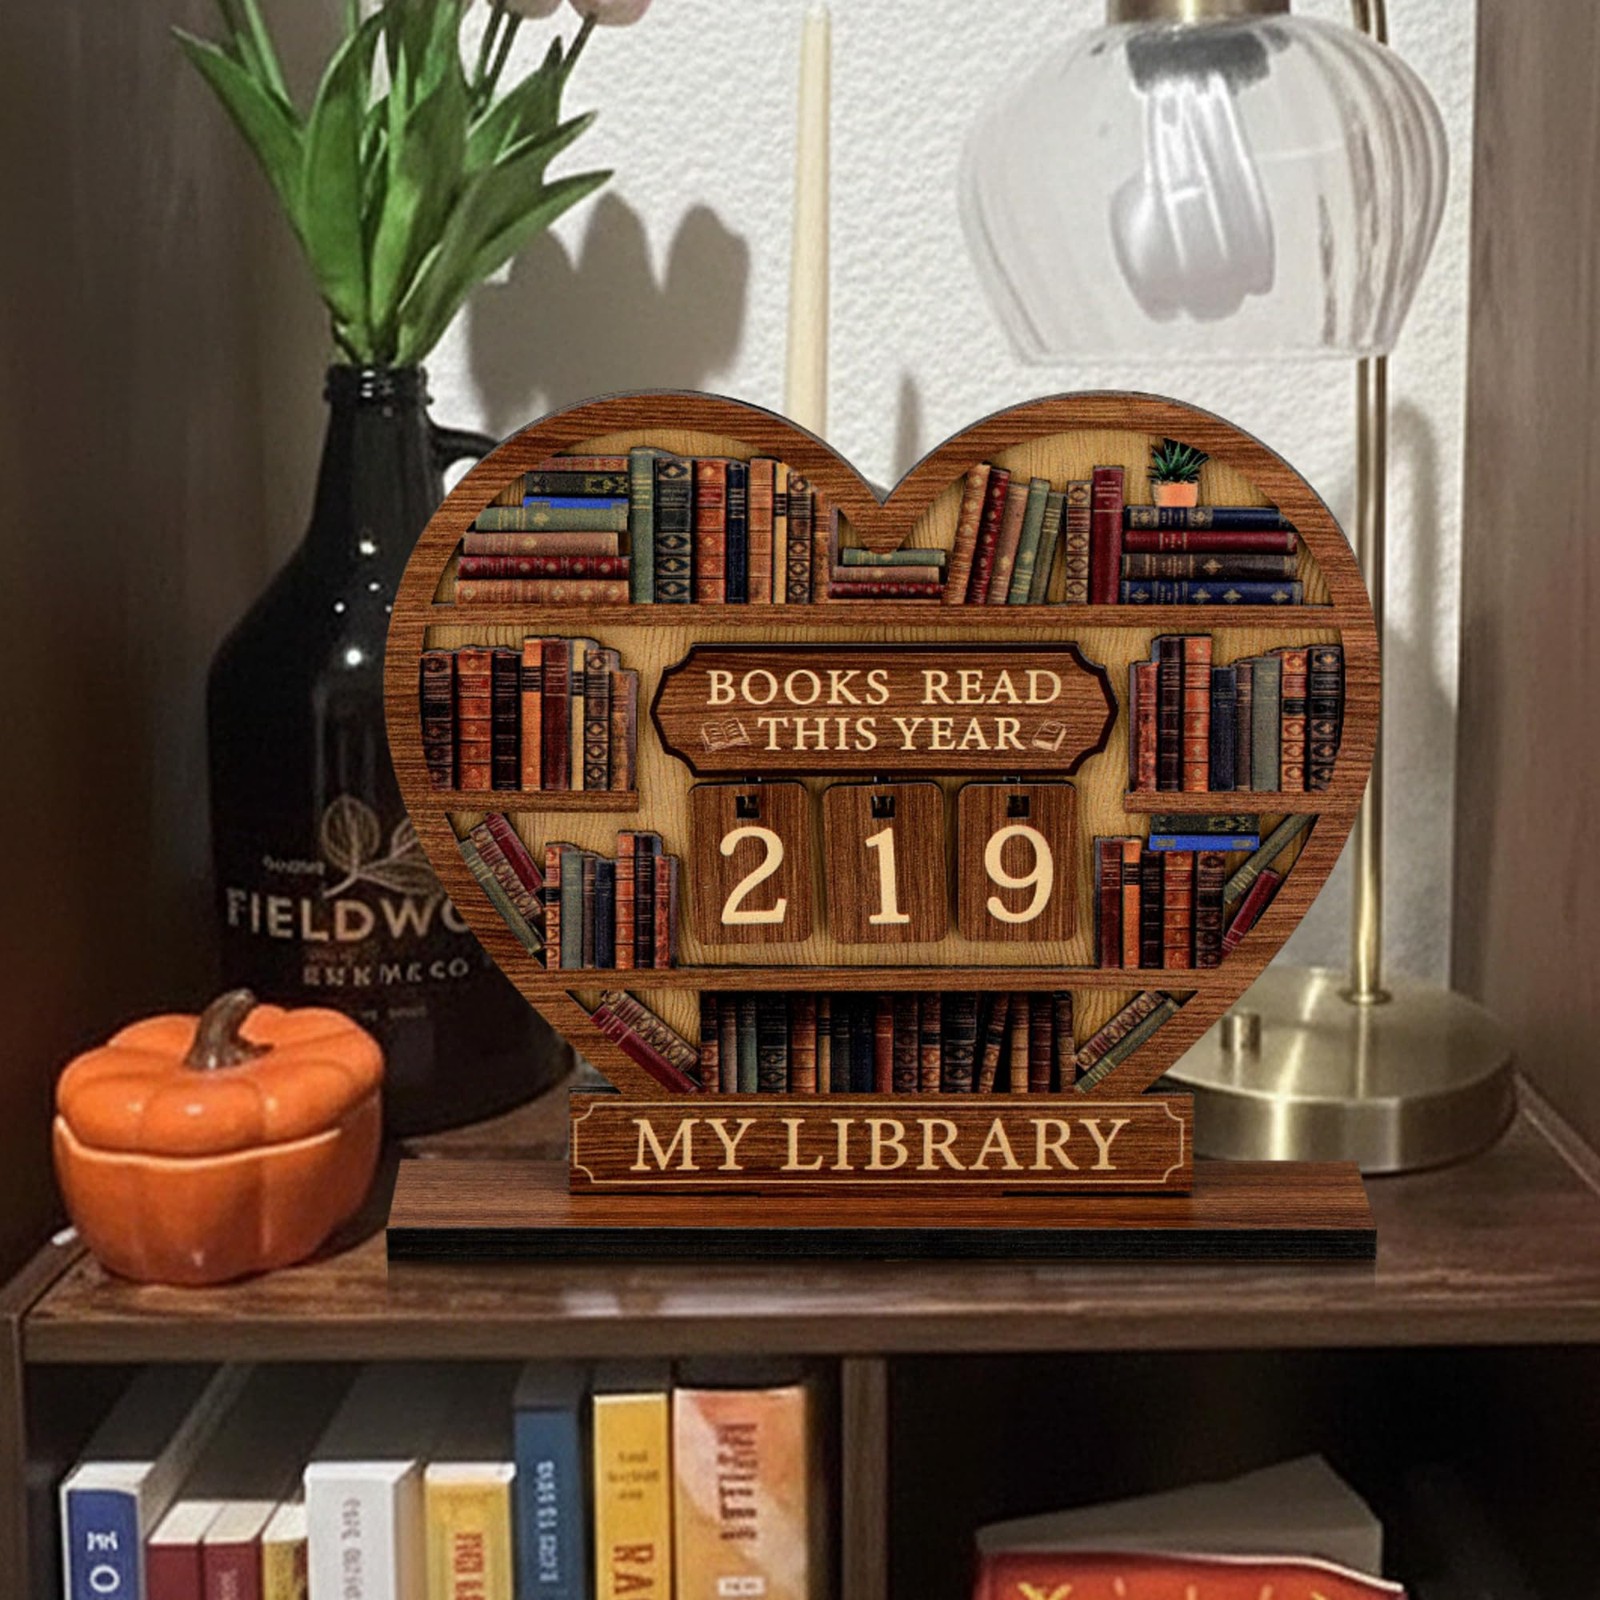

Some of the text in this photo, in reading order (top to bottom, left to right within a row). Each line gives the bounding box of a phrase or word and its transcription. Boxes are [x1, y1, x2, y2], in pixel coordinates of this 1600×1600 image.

[707, 669, 1062, 705] BOOKS READ
[757, 717, 1026, 751] THIS YEAR
[630, 1118, 1130, 1170] MY LIBRARY
